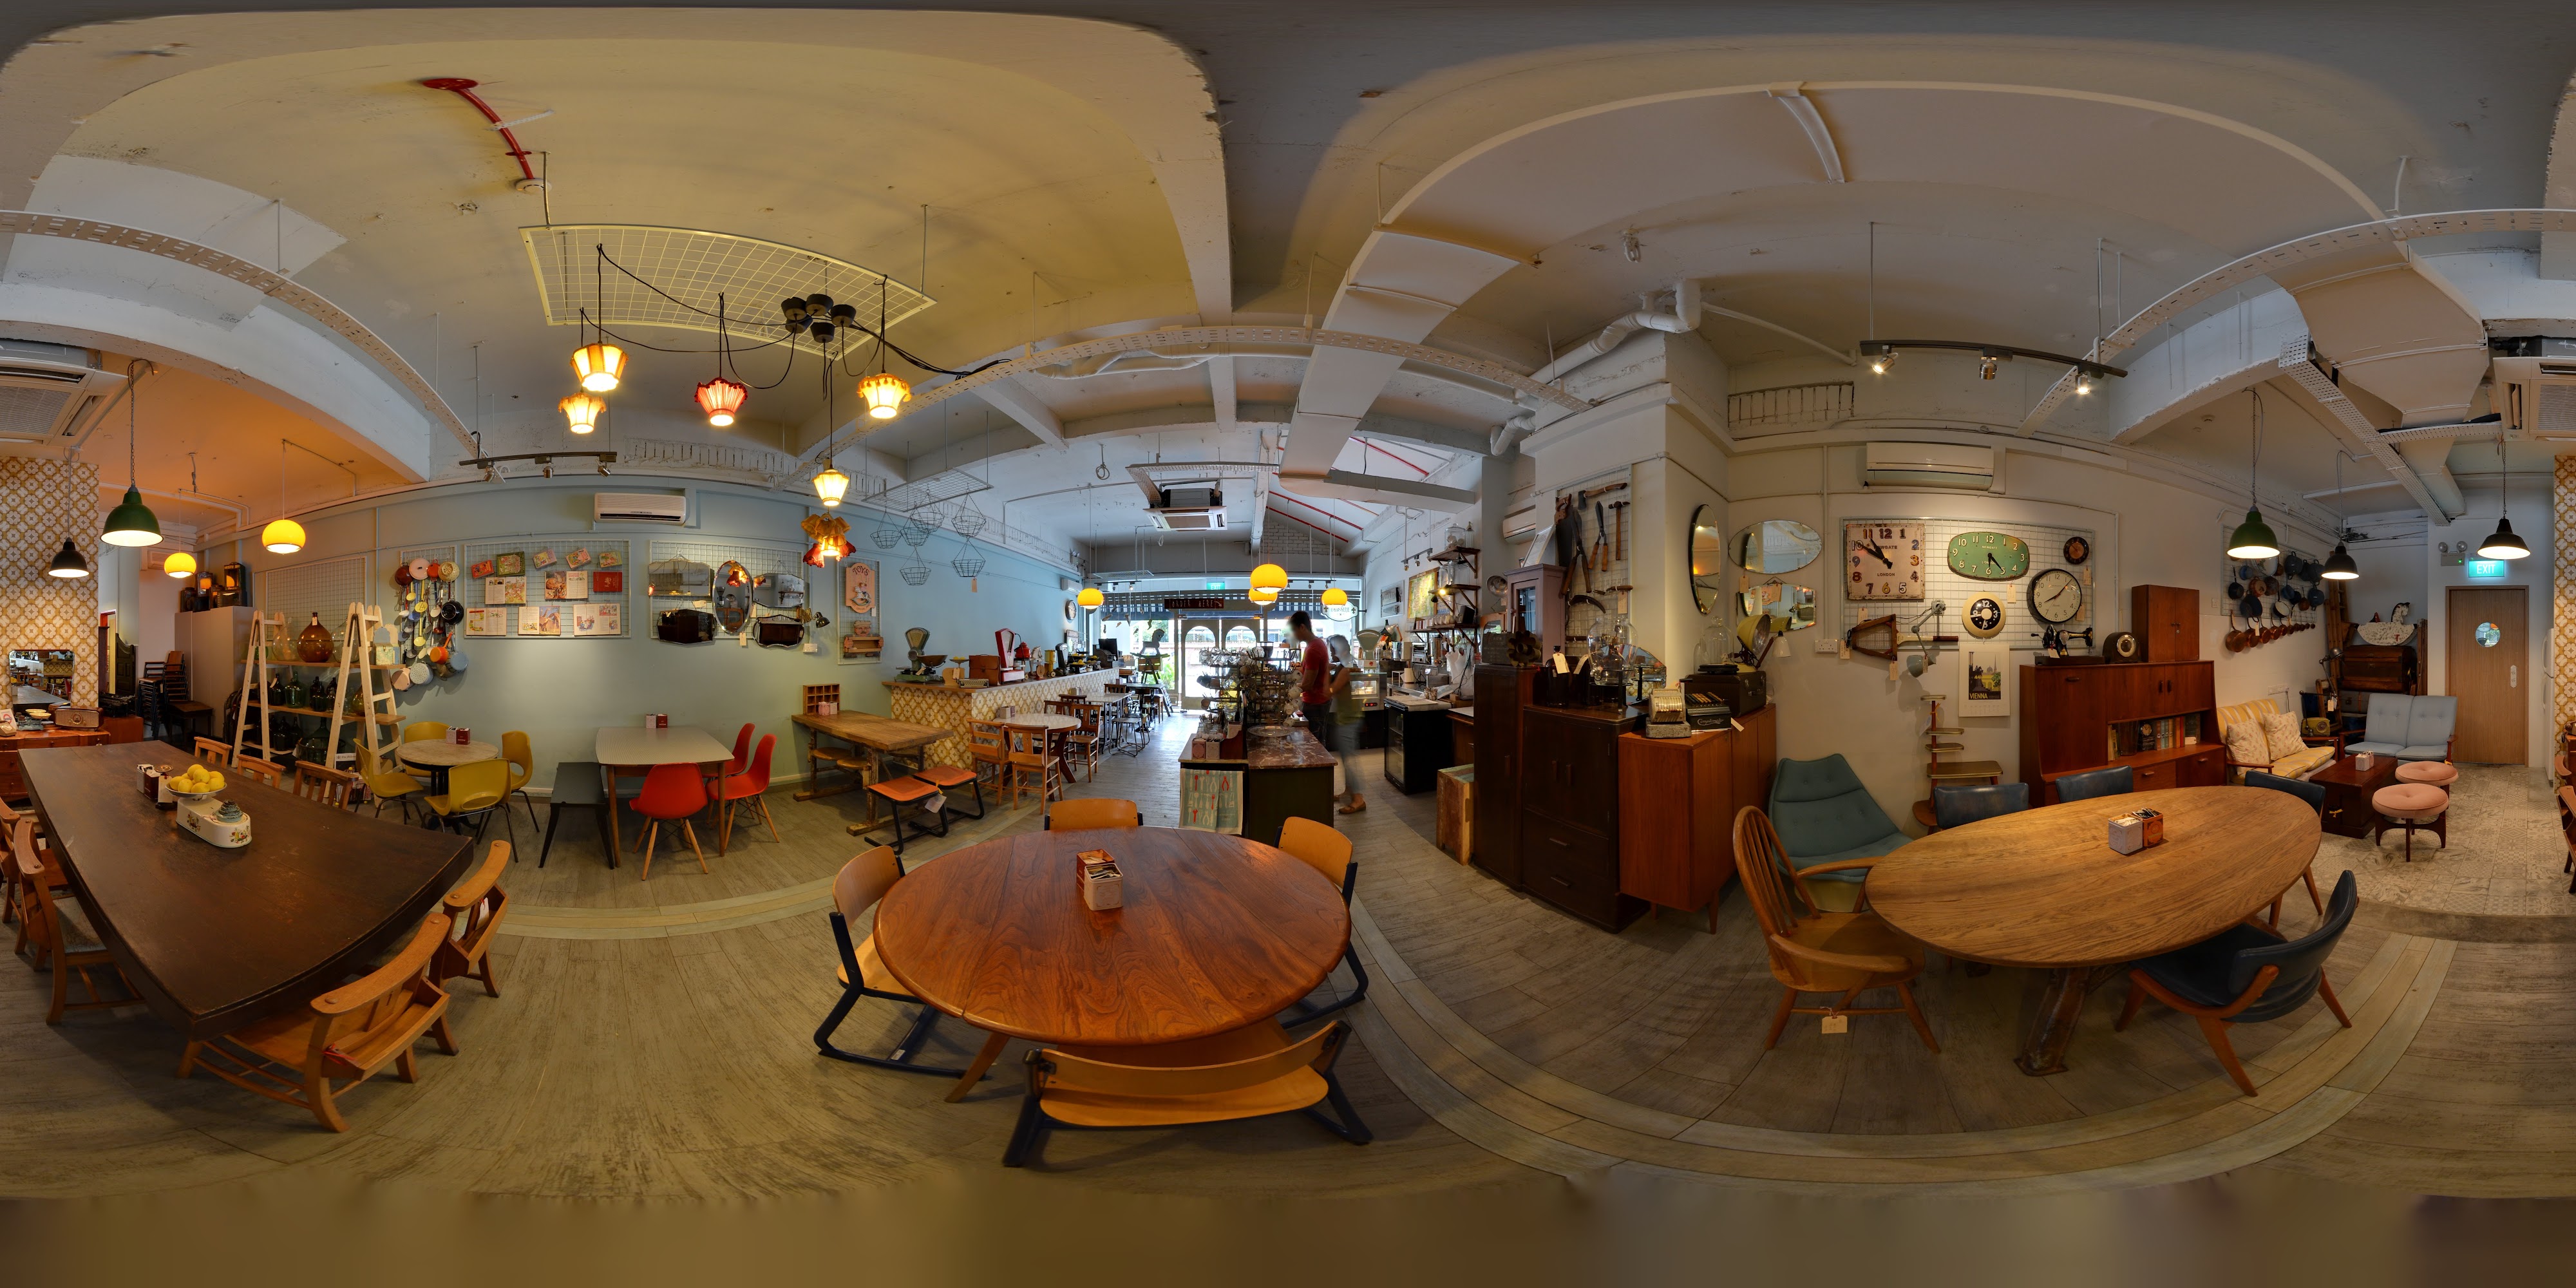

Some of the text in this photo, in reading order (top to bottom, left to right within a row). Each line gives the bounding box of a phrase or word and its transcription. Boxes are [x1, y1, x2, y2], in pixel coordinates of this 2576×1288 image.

[1863, 528, 1873, 539] 11
[1879, 528, 1892, 538] 12
[1900, 528, 1906, 538] 1
[1852, 540, 1864, 551] 10
[1911, 540, 1919, 550] 2
[2003, 538, 2006, 546] 1
[1953, 548, 1958, 556] 9
[2020, 553, 2025, 562] 3
[1852, 556, 1861, 567] 9
[1910, 555, 1919, 566] 3
[853, 565, 869, 576] TOYS
[1971, 565, 1977, 573] 7
[2477, 564, 2496, 574] EXIT
[1852, 571, 1862, 583] 8
[1910, 570, 1919, 582] 4
[1866, 582, 1873, 594] 7
[1882, 582, 1890, 594] 6
[1899, 582, 1907, 594] 5
